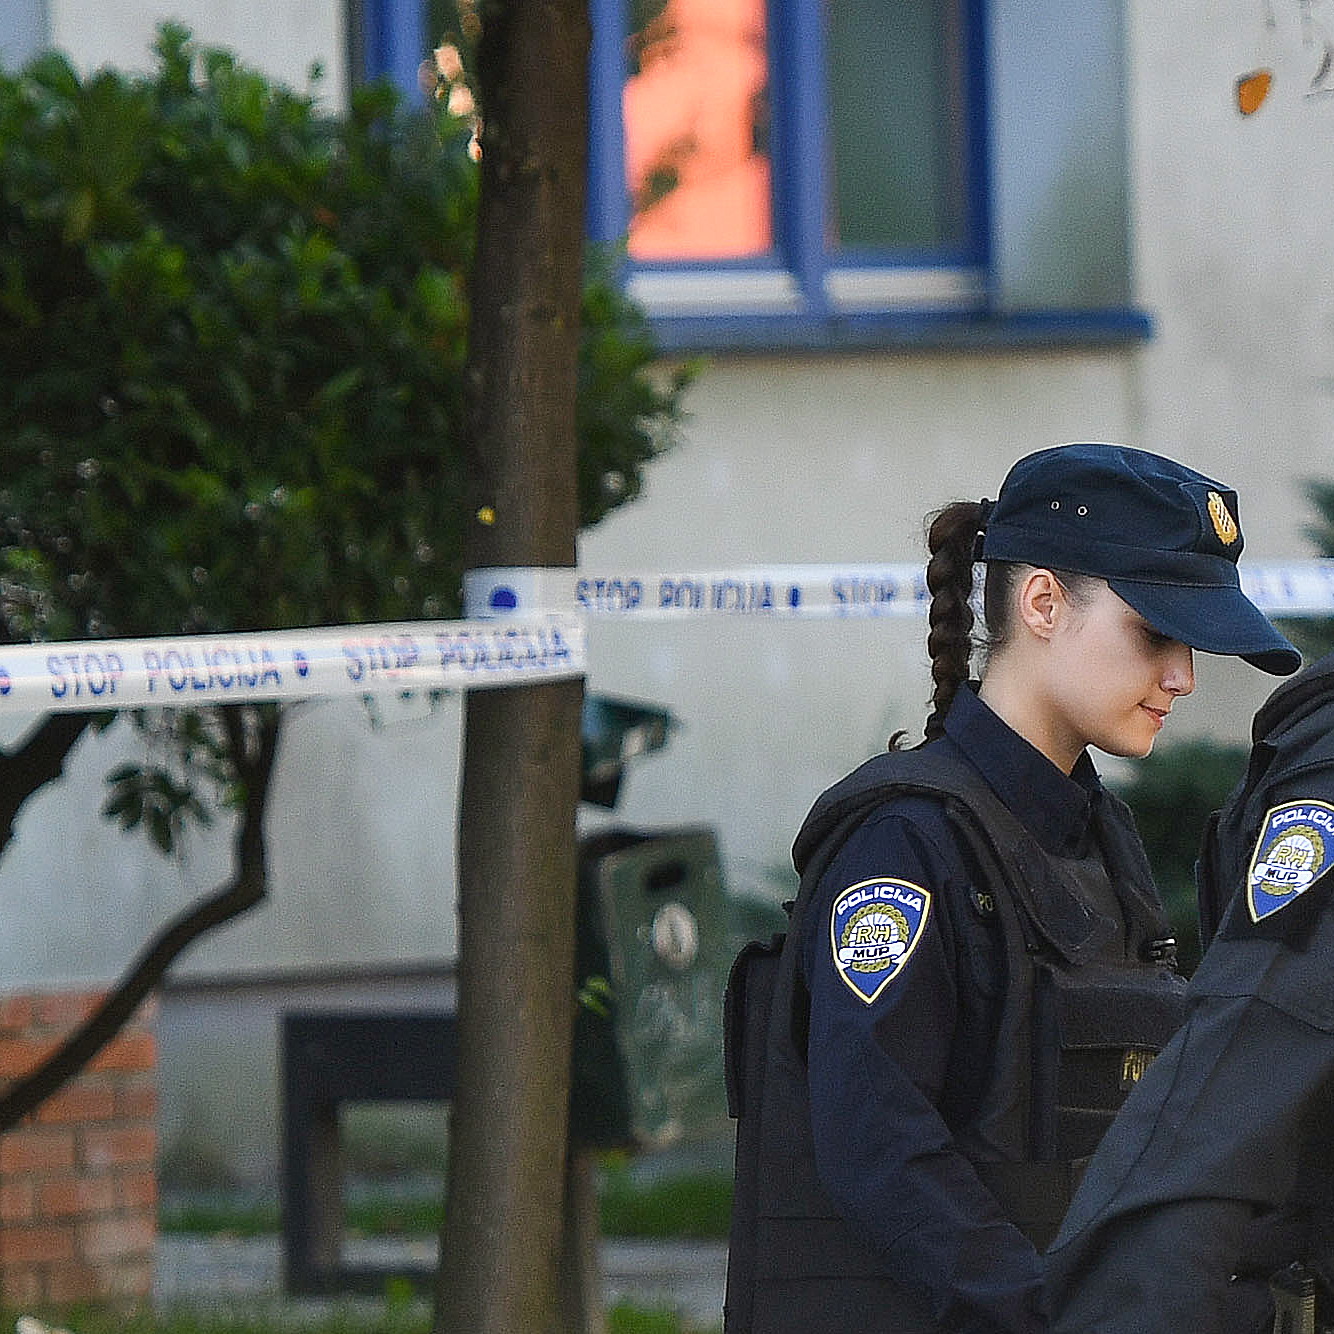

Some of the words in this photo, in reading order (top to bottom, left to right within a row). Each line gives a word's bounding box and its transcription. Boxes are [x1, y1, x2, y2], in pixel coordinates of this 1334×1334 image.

[46, 654, 126, 701] STOP
[145, 649, 283, 694] POLICIJA
[1274, 846, 1309, 869] RH
[1265, 867, 1299, 881] MUP
[836, 885, 923, 916] POLICIJA
[855, 924, 892, 944] RH
[852, 946, 891, 959] MUP
